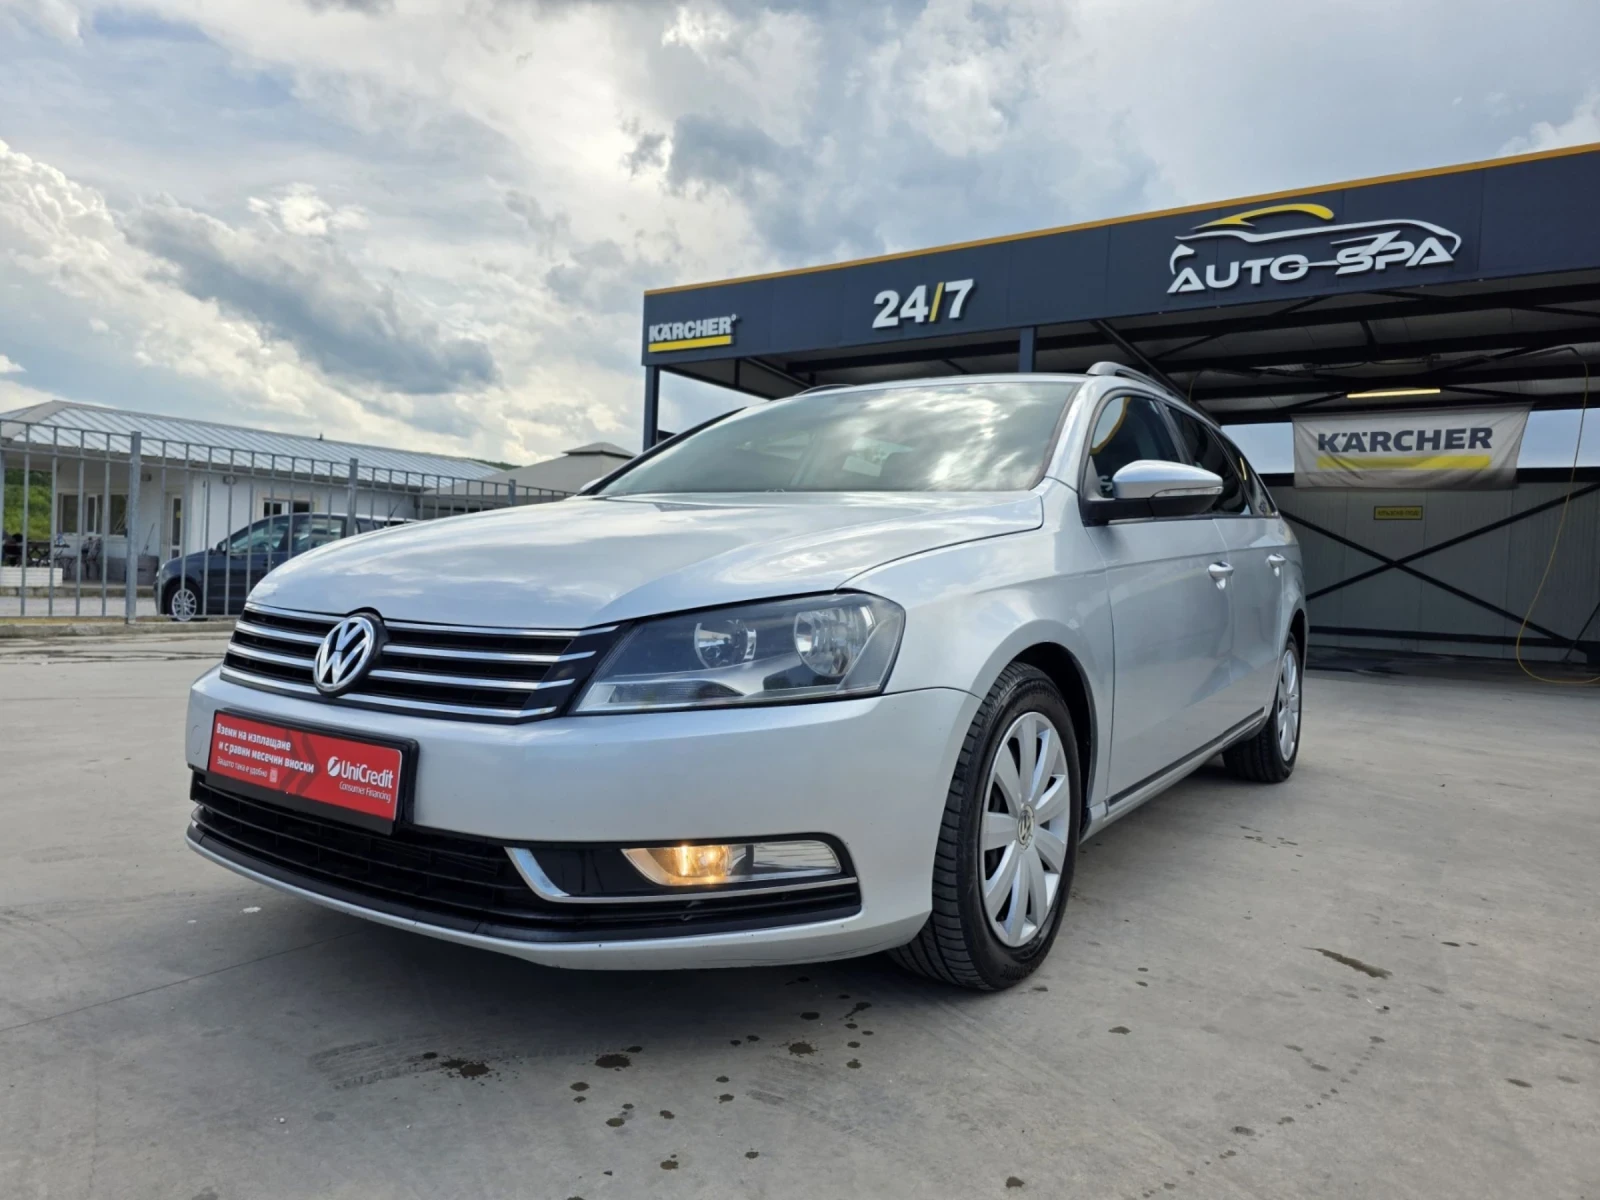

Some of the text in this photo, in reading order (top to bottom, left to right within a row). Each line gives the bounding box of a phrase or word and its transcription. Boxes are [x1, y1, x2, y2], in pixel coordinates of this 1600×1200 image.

[1167, 254, 1309, 293] AUTO
[872, 279, 974, 328] 24/7
[1317, 427, 1493, 453] KÄRCHER
[216, 722, 291, 751] Вземи на изплащане
[229, 743, 251, 758] равни
[251, 750, 284, 766] месечни
[284, 757, 315, 774] вноски
[341, 759, 394, 789] UniCredit
[339, 780, 392, 804] Consumer Financing
